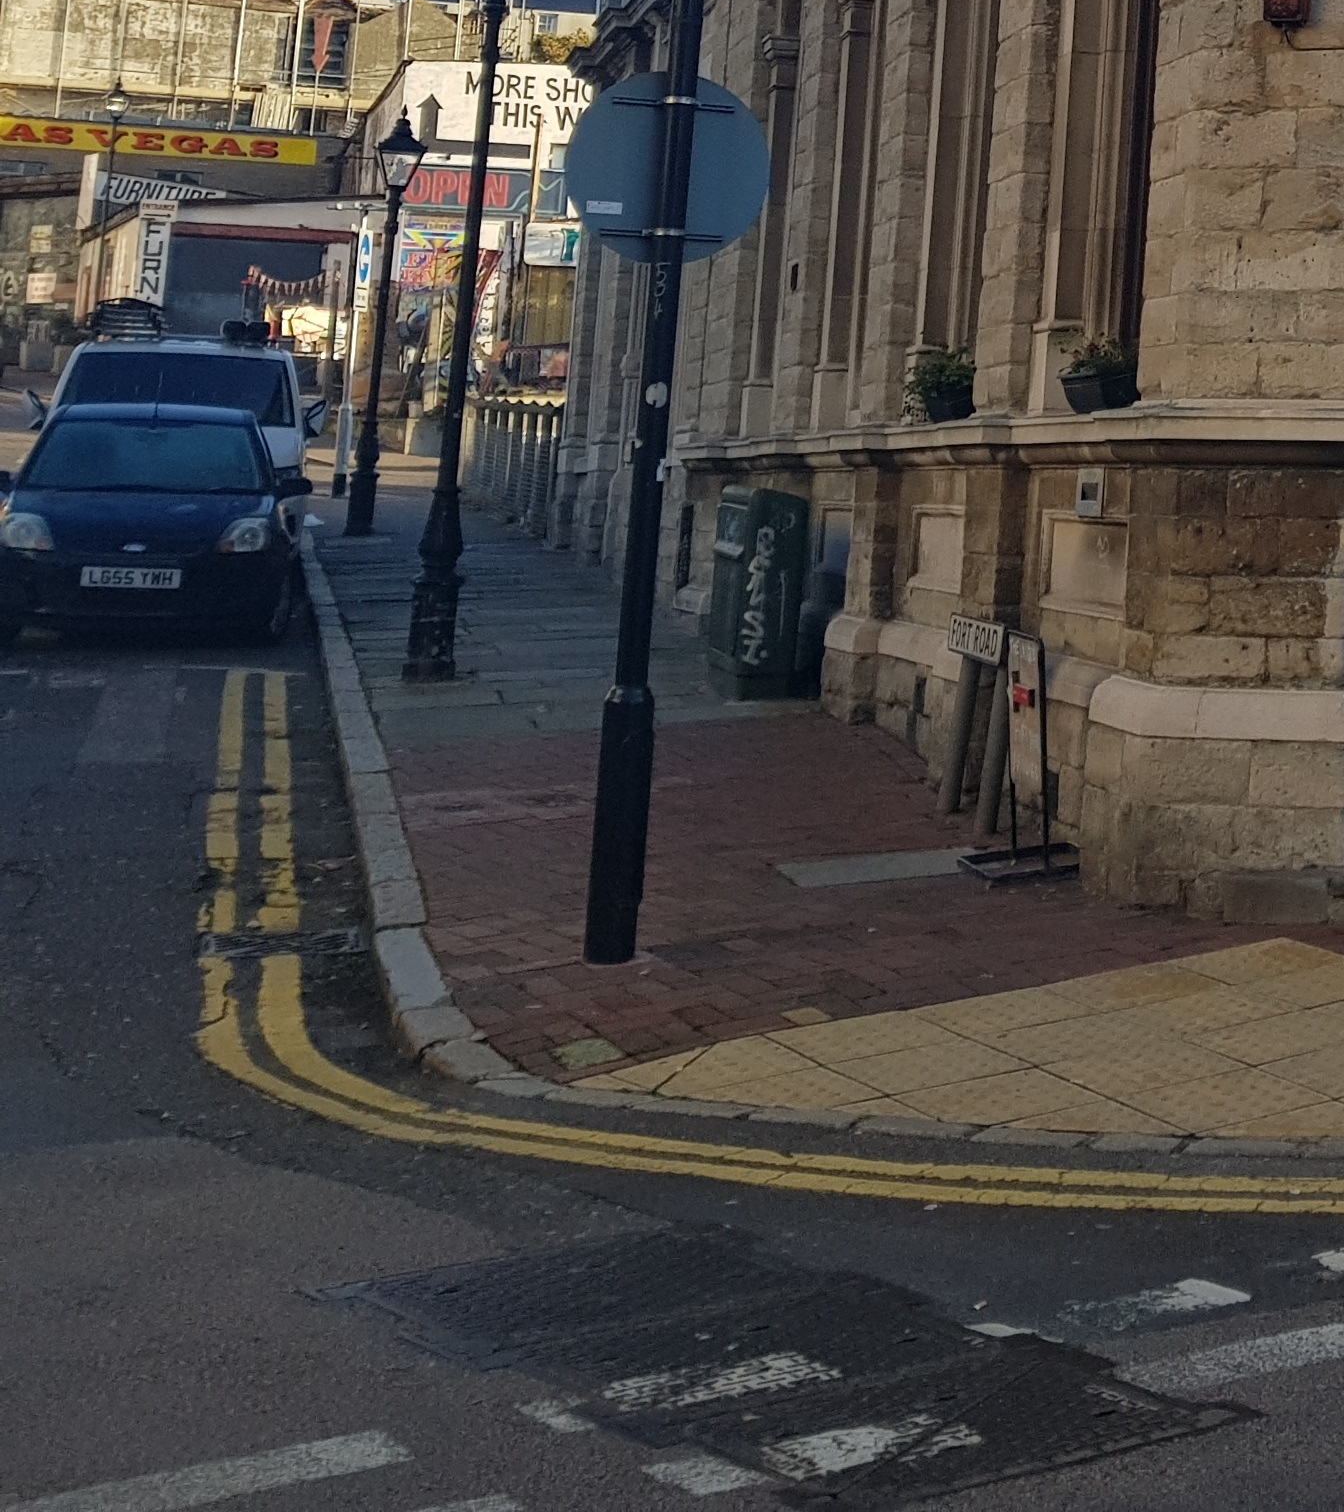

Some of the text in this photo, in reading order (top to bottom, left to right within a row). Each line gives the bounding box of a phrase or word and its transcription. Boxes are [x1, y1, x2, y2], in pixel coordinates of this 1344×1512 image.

[86, 127, 280, 158] VEGAS
[952, 619, 973, 646] FORT
[973, 624, 998, 657] ROAD
